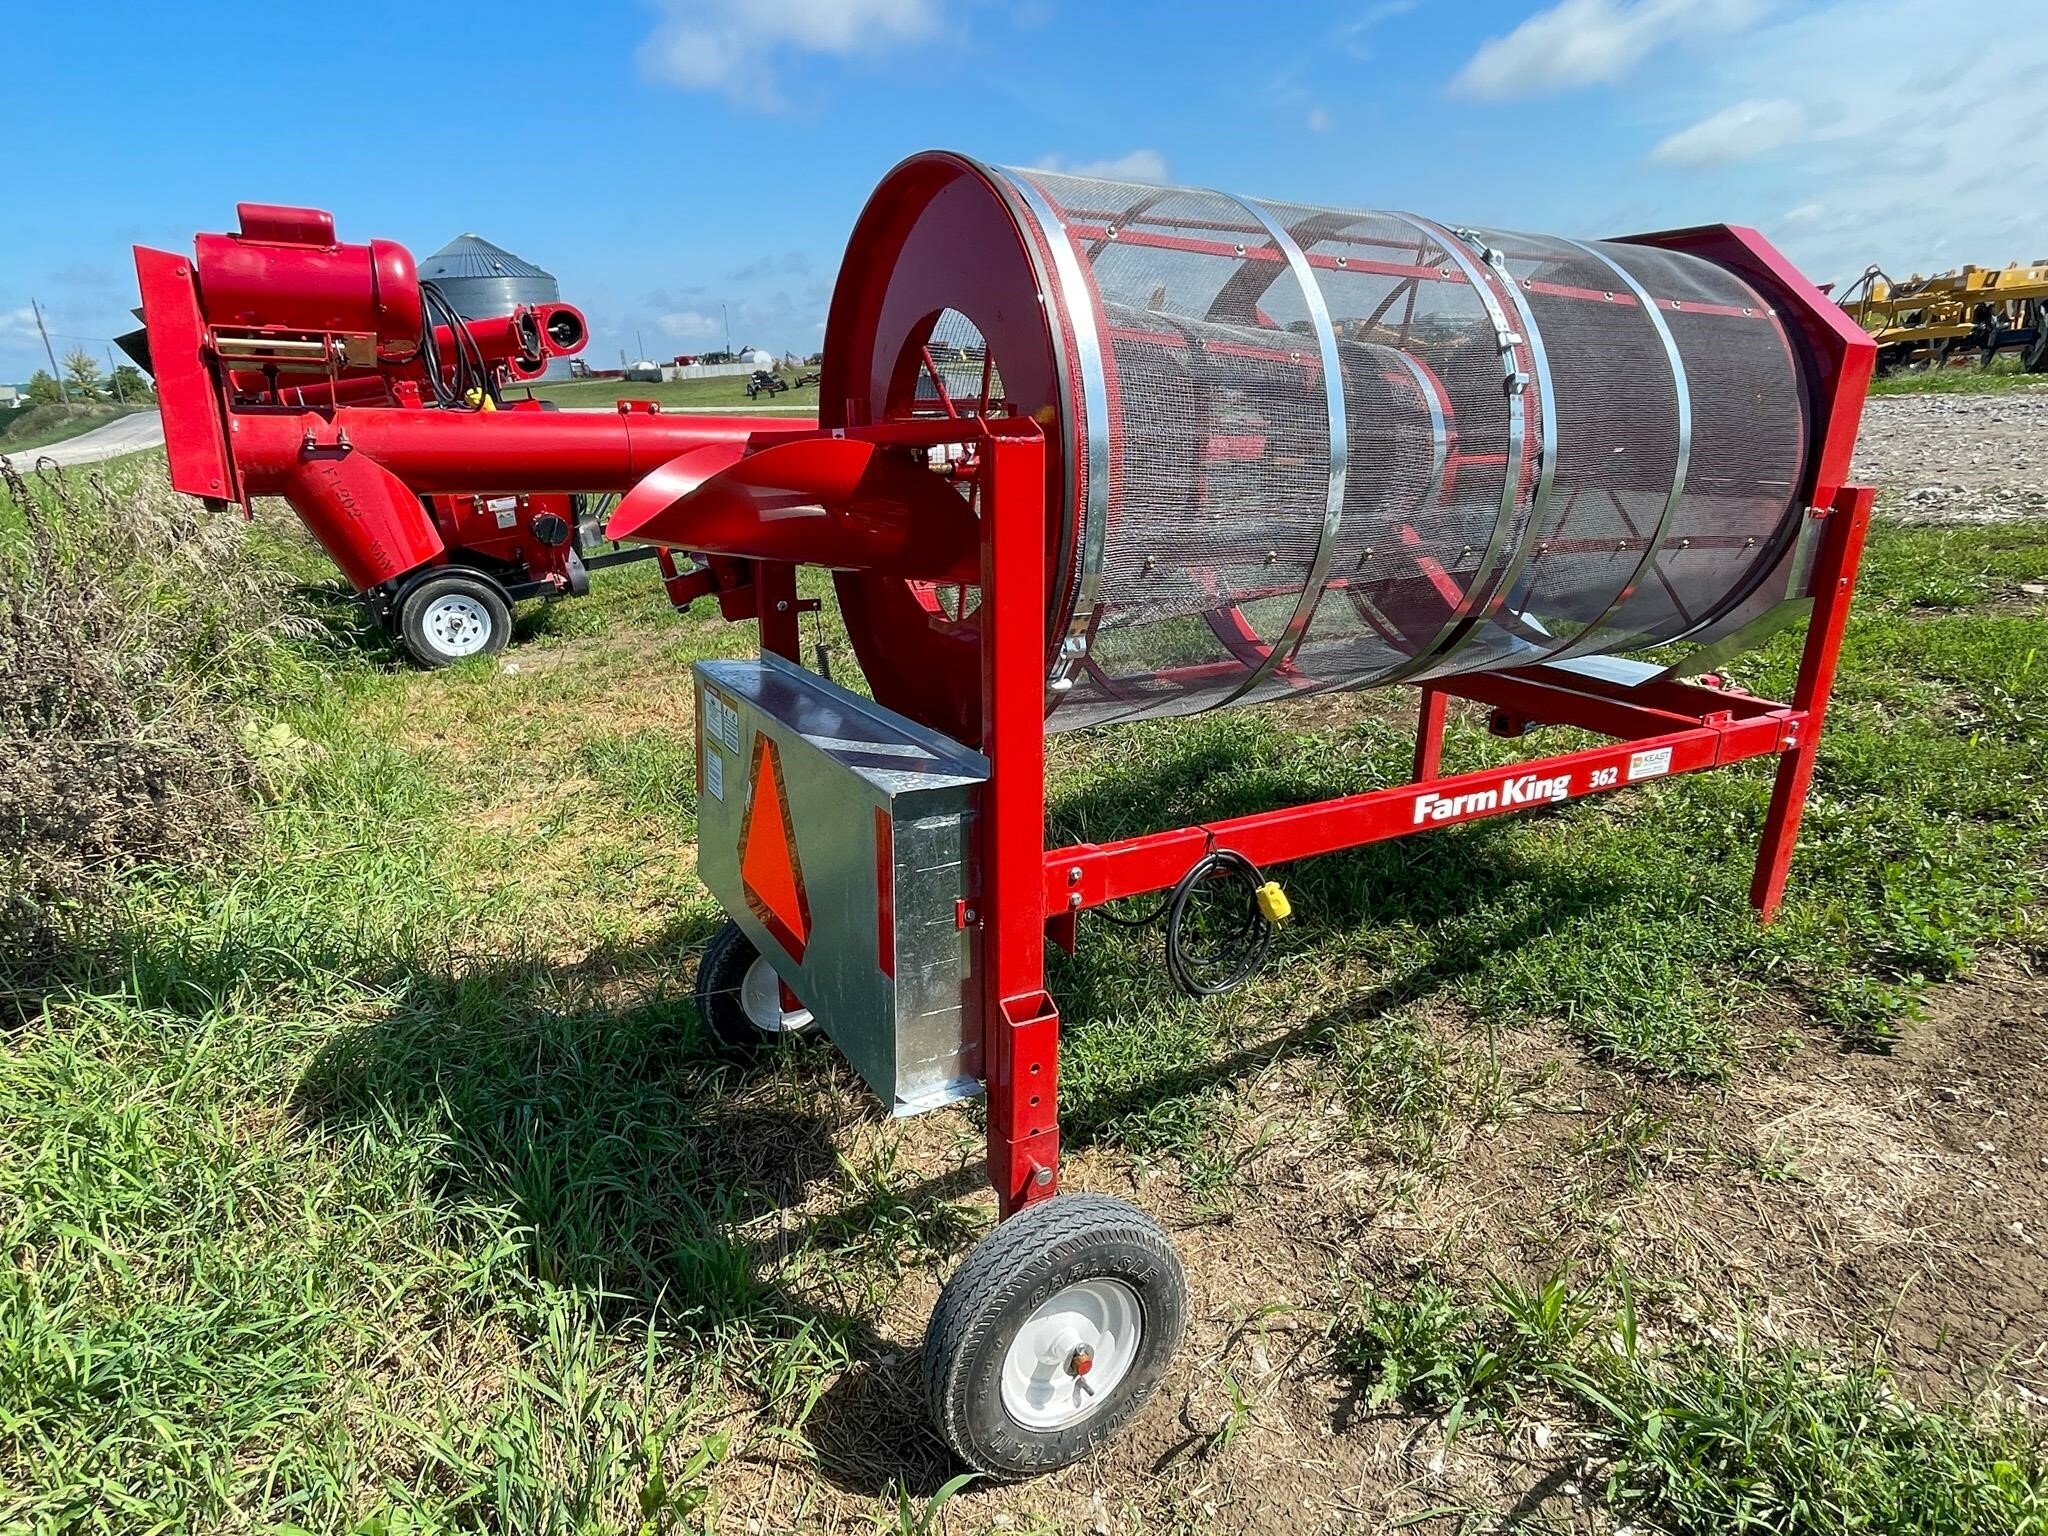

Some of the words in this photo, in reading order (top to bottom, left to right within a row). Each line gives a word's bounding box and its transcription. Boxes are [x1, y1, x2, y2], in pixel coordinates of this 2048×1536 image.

[1644, 751, 1670, 762] KEAST
[1589, 766, 1619, 788] 362
[1413, 789, 1498, 825] Farm
[1501, 774, 1572, 807] King
[1029, 1254, 1160, 1310] CARLISLE
